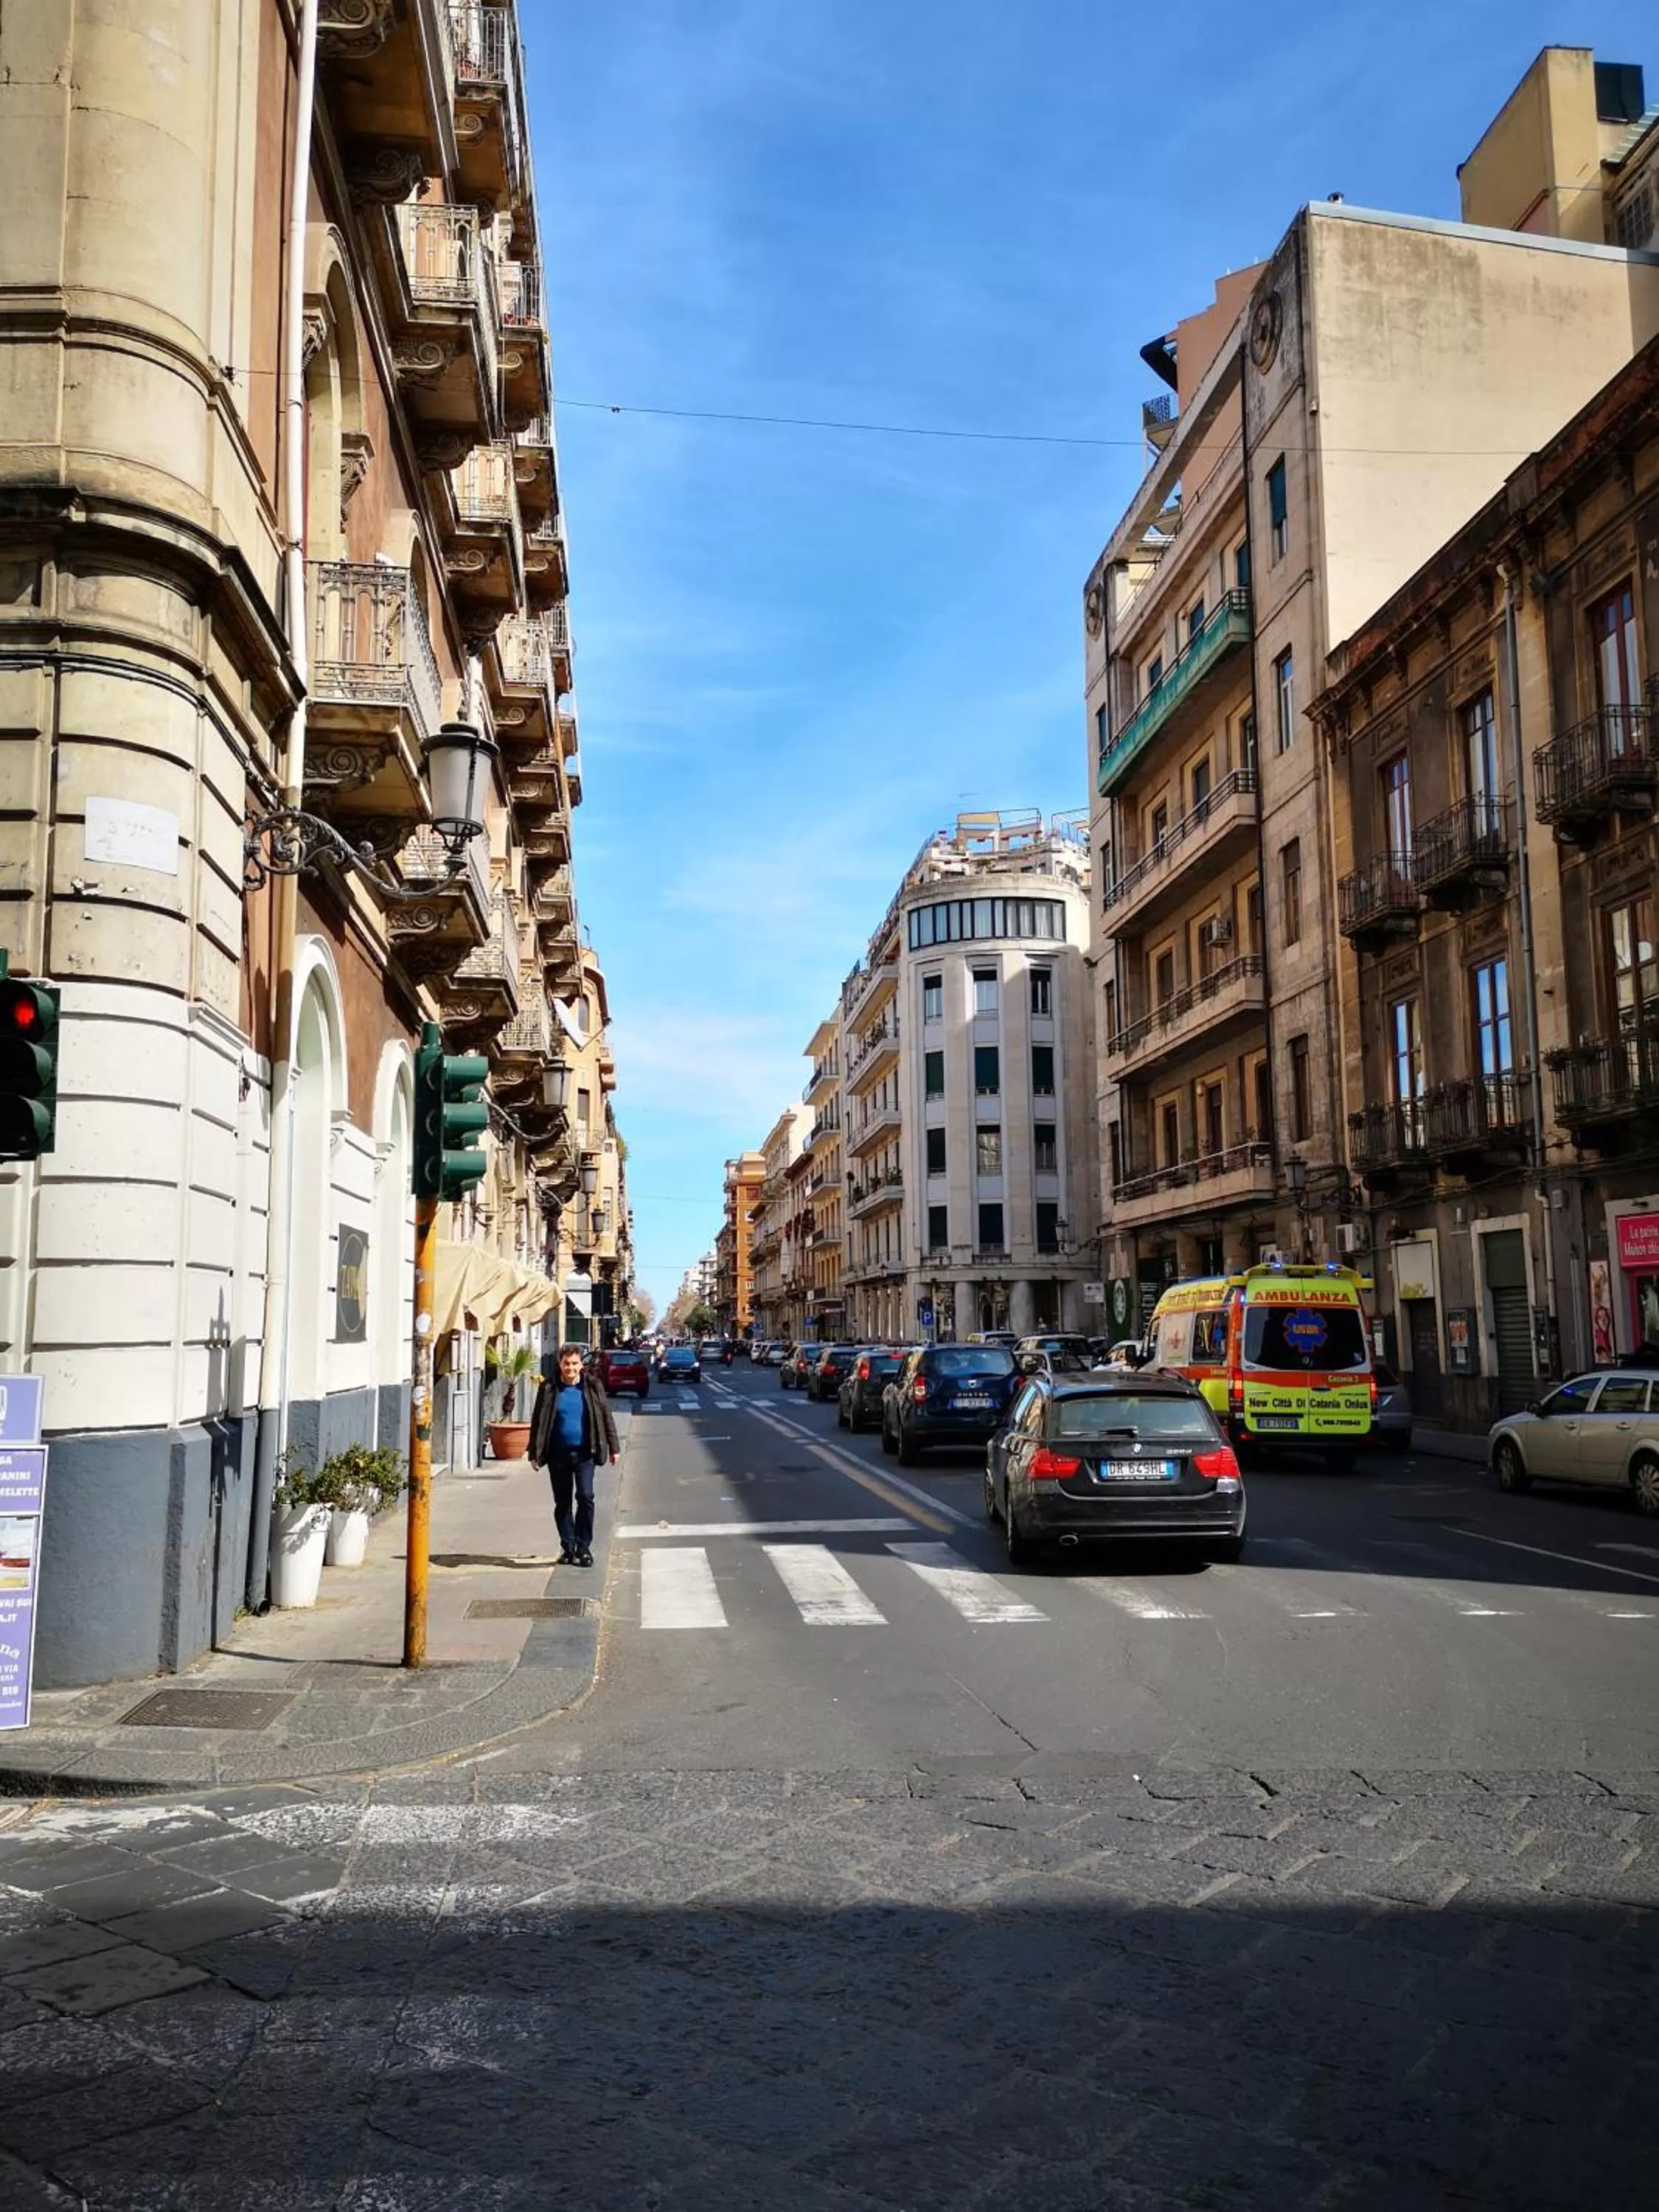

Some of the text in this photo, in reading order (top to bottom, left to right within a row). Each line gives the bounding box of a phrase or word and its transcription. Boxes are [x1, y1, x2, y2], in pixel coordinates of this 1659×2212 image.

[1253, 1290, 1351, 1302] AMBULANZA
[1249, 1398, 1267, 1408] New
[1310, 1398, 1341, 1408] Catania
[1345, 1398, 1368, 1408] Onlus
[0, 1471, 30, 1481] ANINI
